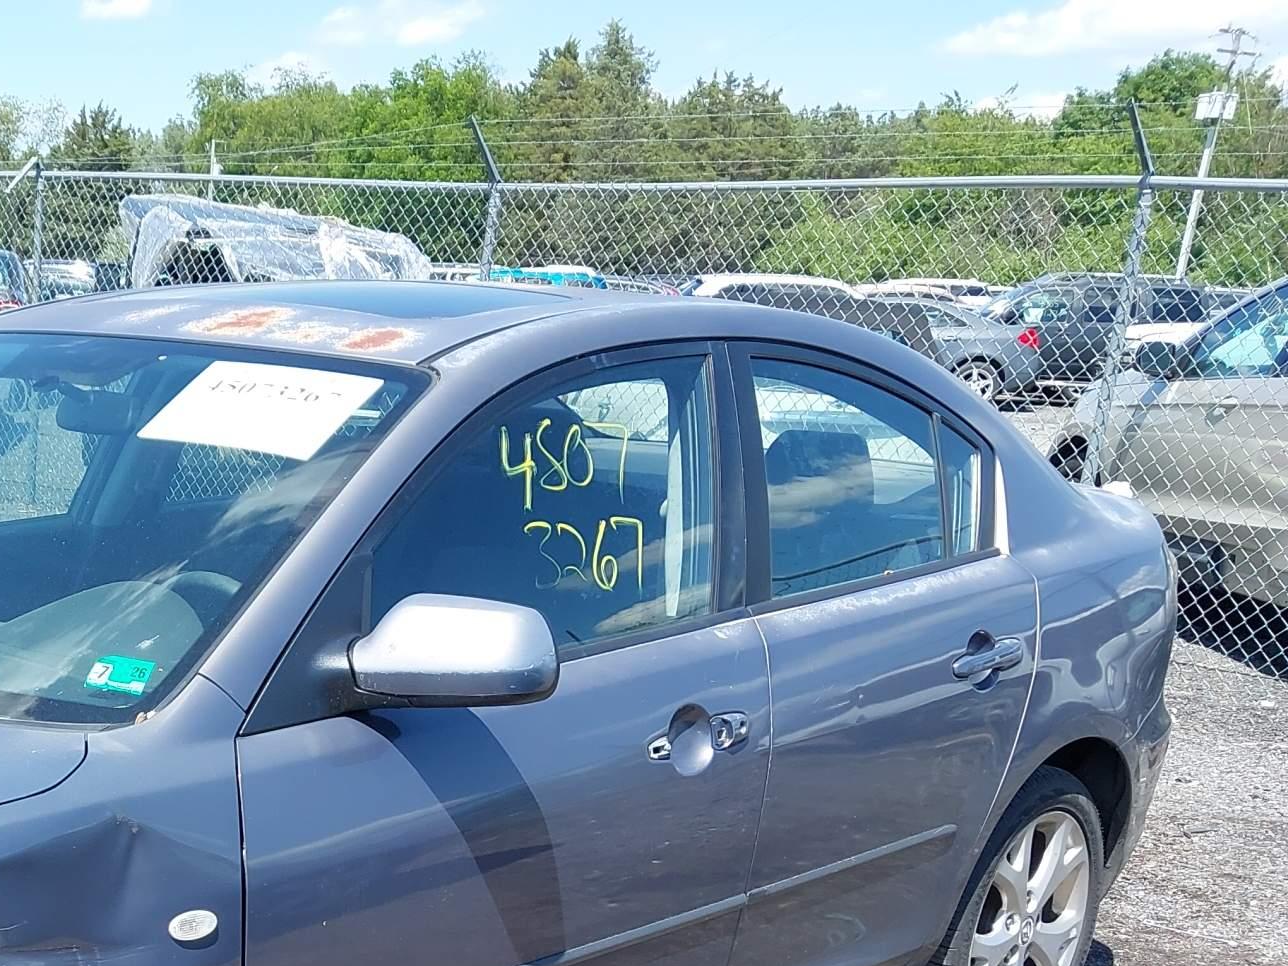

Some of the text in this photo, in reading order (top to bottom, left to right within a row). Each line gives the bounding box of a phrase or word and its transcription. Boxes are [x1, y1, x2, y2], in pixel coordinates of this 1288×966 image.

[523, 516, 643, 598] 3267
[97, 665, 148, 679] 7 26
